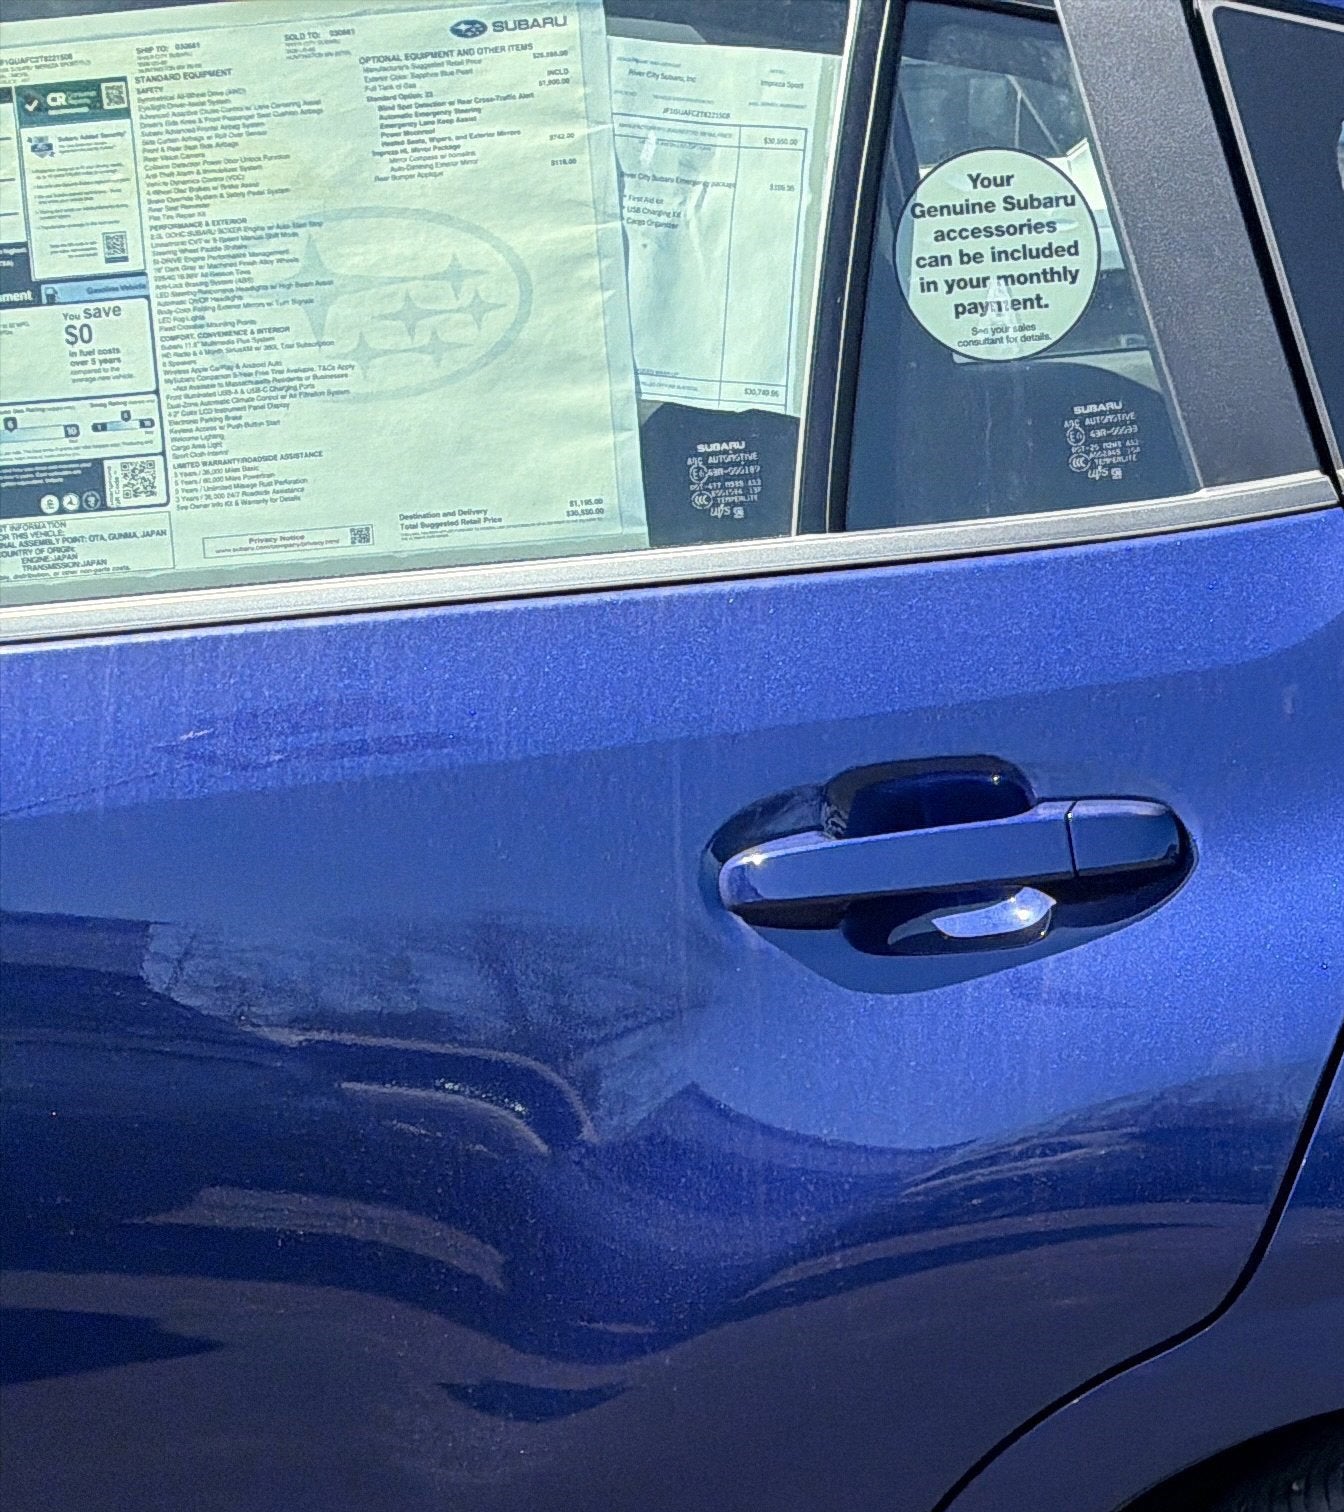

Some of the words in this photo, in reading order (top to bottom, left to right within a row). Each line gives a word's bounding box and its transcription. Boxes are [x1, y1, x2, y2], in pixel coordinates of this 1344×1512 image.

[492, 15, 567, 32] SUBARU
[359, 54, 401, 65] OPTIONAL
[404, 50, 454, 61] EQUIPMENT
[457, 48, 474, 57] AND
[477, 45, 505, 54] OTHER
[508, 43, 532, 52] ITEMS
[134, 72, 180, 83] STANDARD
[183, 68, 232, 79] EQUIPMENT
[967, 173, 1014, 191] Your
[911, 198, 996, 219] Genuine
[1003, 192, 1076, 211] Subaru
[934, 219, 1057, 242] accessories
[916, 253, 952, 269] can
[959, 248, 985, 265] be
[991, 240, 1079, 263] included
[920, 276, 938, 293] in
[944, 276, 990, 294] your
[996, 266, 1080, 287] monthly
[62, 311, 80, 321] You
[82, 304, 121, 319] save
[64, 323, 92, 346] $0
[991, 325, 1009, 335] your
[958, 336, 1003, 347] consultant
[1006, 335, 1017, 343] for
[79, 348, 94, 356] fuel
[98, 346, 120, 355] costs
[98, 356, 121, 366] years
[1073, 401, 1122, 414] SUBARU
[697, 441, 746, 452] SUBARU
[141, 529, 166, 537] JAPAN
